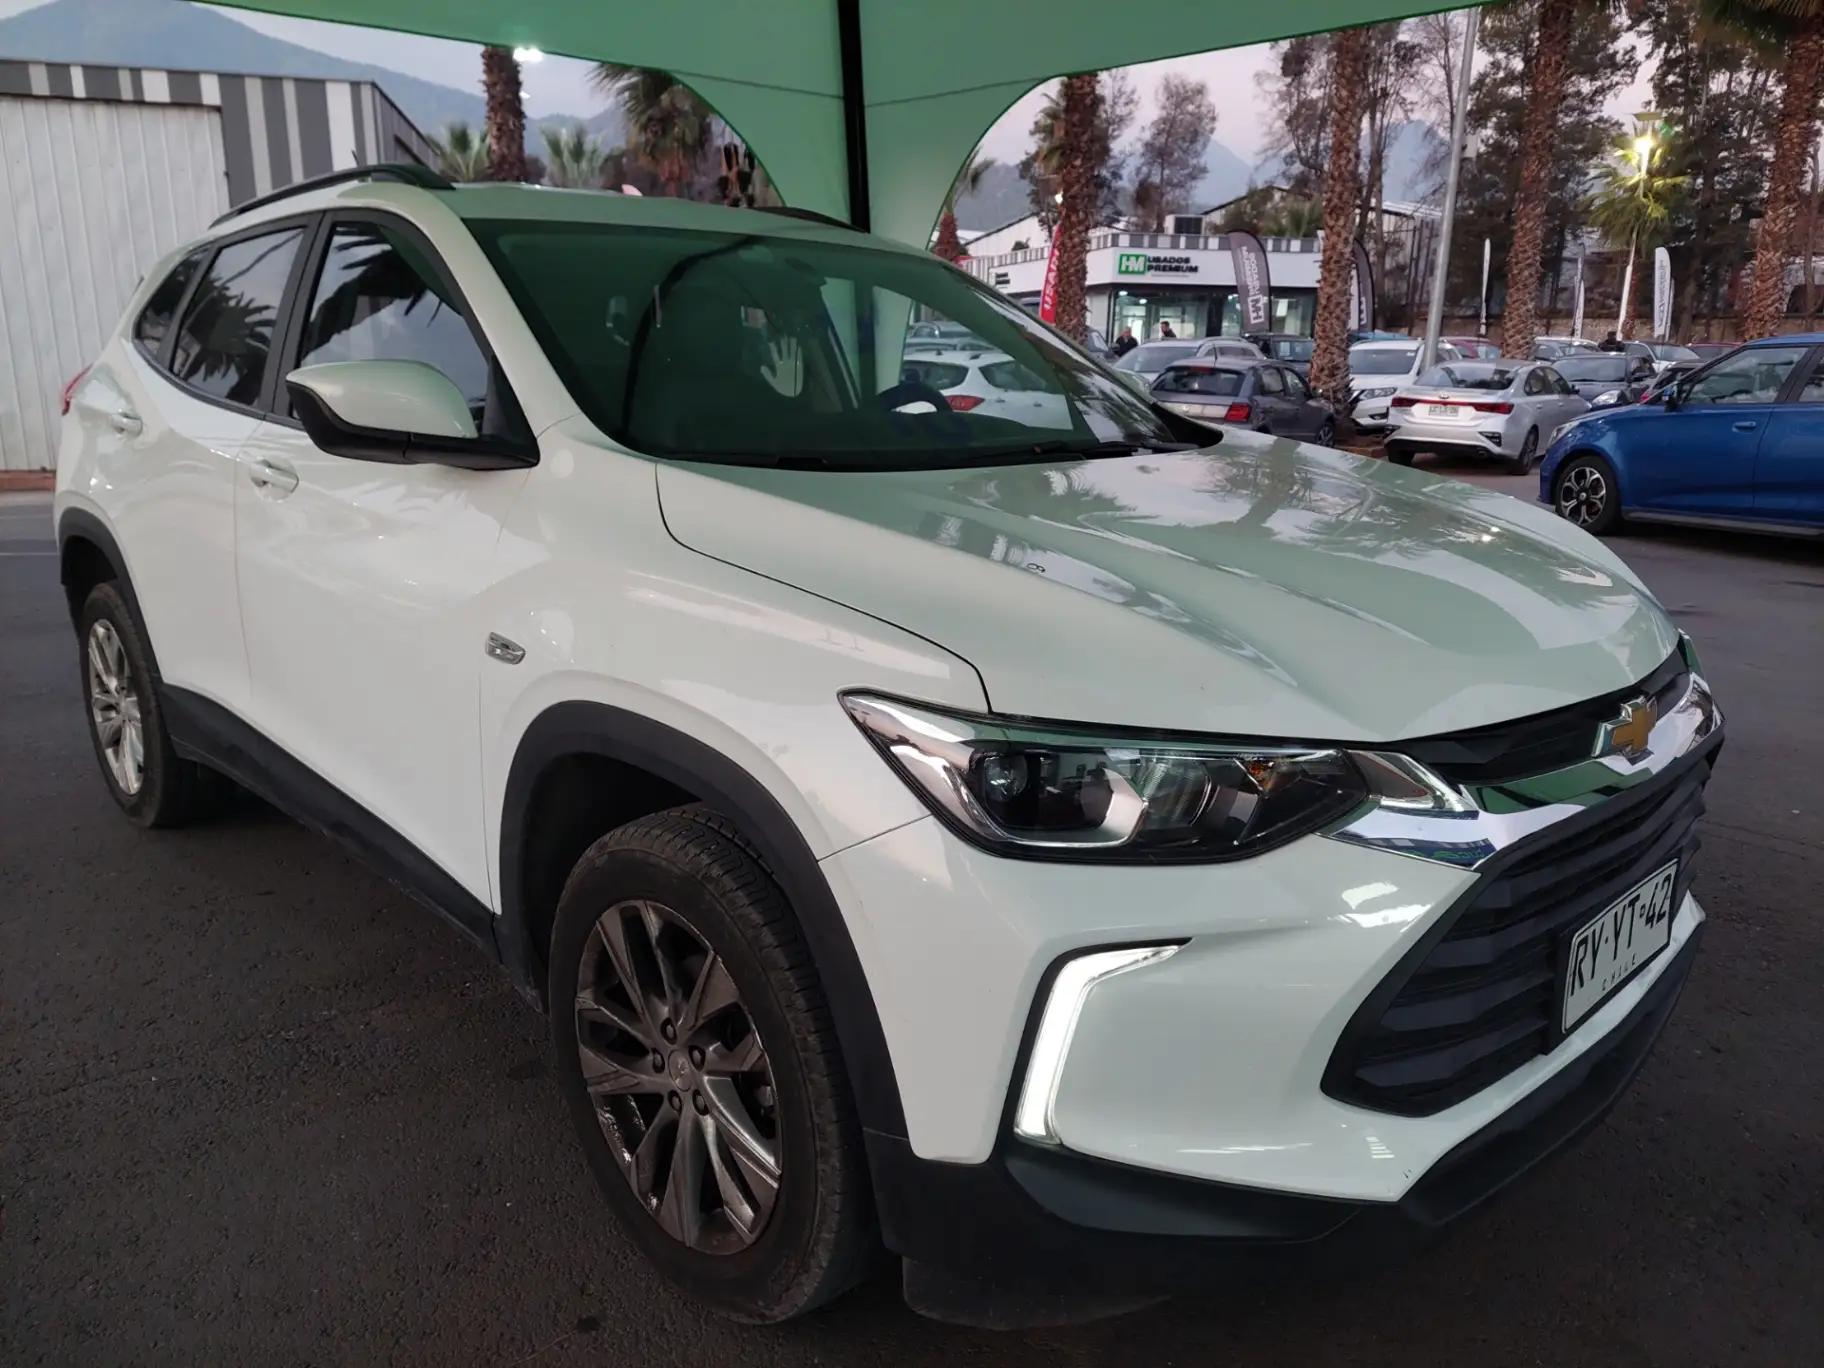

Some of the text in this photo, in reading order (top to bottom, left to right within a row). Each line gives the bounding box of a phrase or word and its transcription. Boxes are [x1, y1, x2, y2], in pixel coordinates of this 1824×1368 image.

[1120, 255, 1146, 273] HM
[1147, 256, 1191, 264] USADOS
[1147, 264, 1199, 273] PREMIUM
